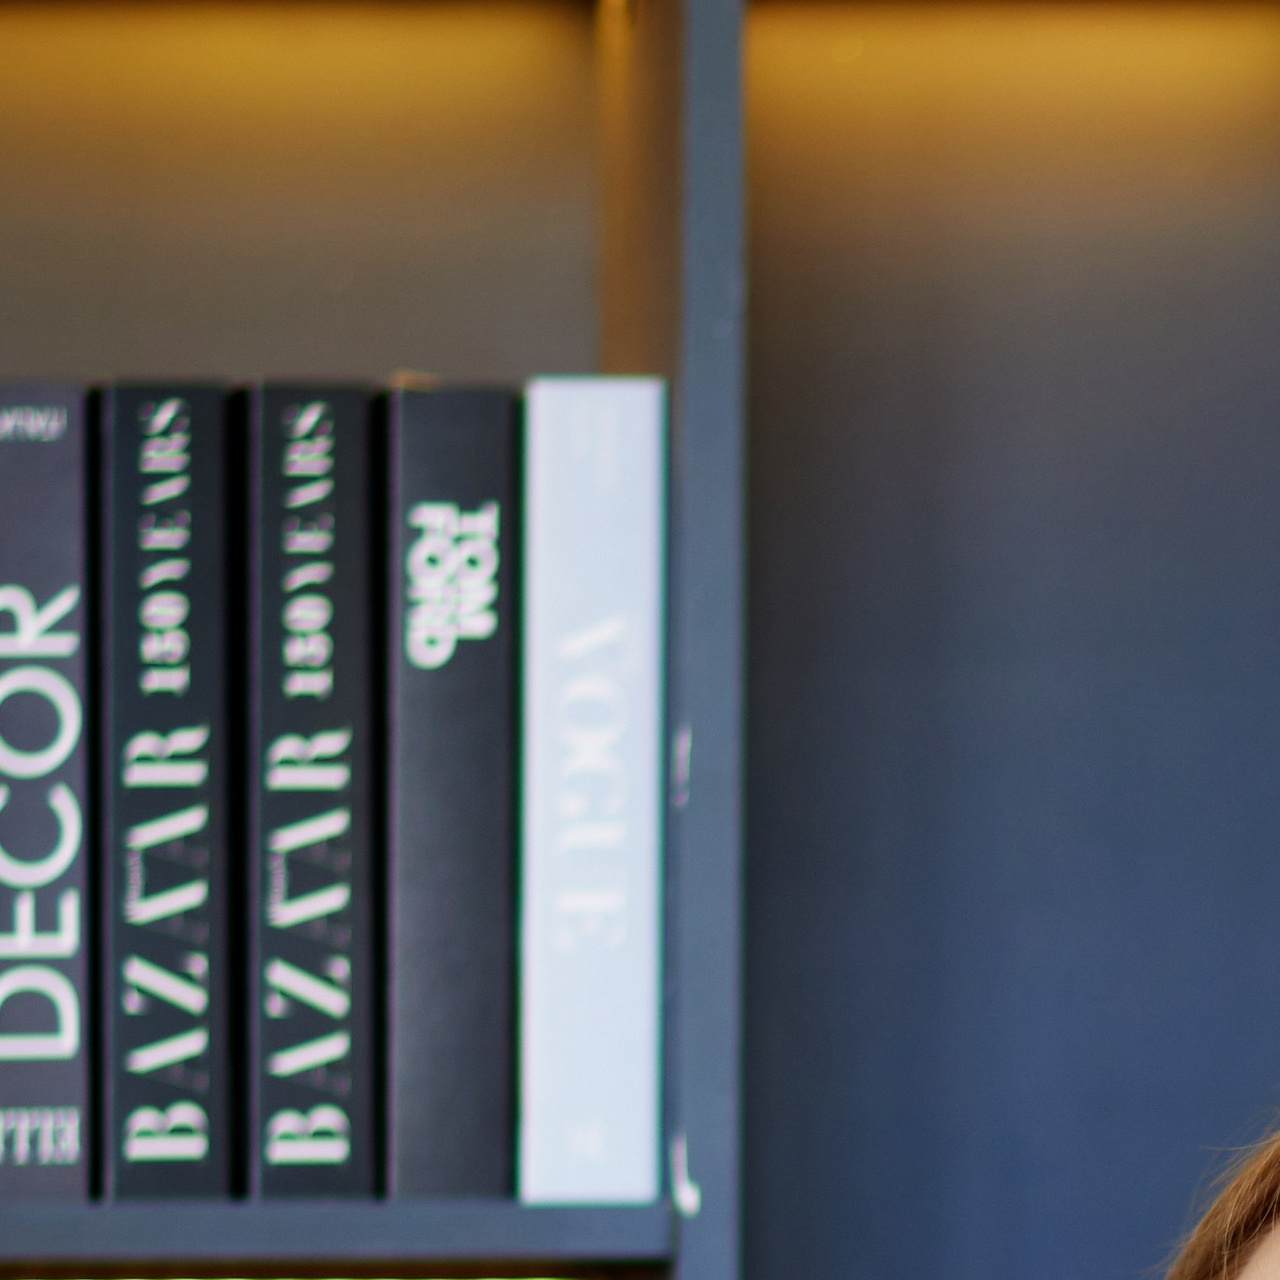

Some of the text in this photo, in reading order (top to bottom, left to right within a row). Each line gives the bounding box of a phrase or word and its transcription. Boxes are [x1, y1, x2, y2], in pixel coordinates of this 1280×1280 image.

[406, 503, 459, 670] FORD
[459, 501, 500, 639] TOM
[0, 583, 82, 1060] DECOR
[124, 724, 209, 1162] BAZAAR
[266, 727, 352, 1165] BAZAAR
[557, 614, 631, 952] VOGUE
